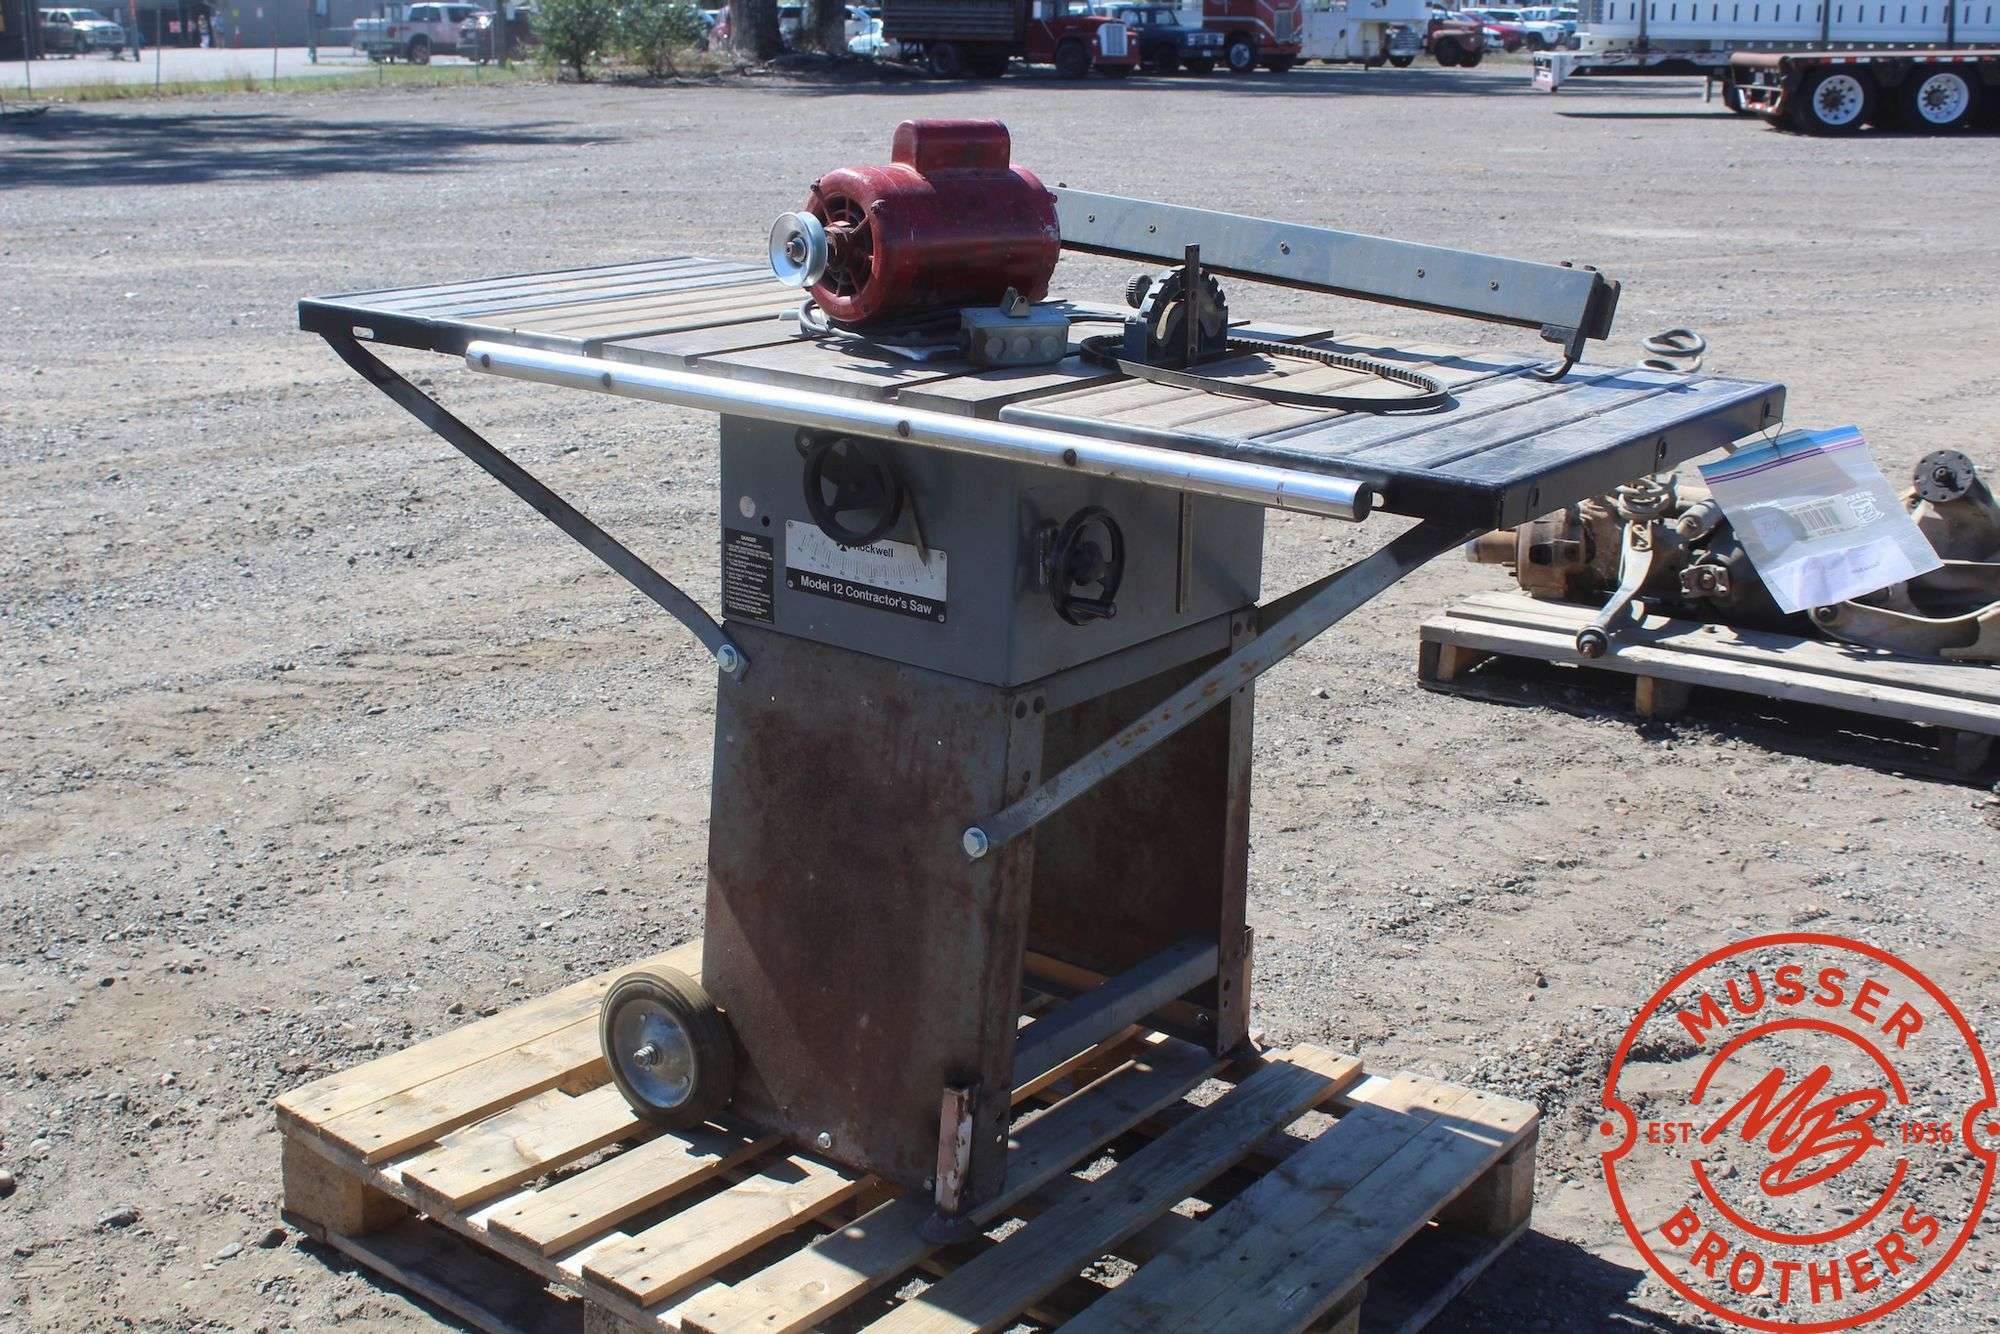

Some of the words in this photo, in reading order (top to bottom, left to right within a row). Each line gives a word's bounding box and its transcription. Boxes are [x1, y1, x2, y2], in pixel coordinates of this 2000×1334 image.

[800, 575, 830, 591] Model
[832, 583, 844, 595] 12
[845, 586, 908, 609] Contractor's
[909, 599, 933, 615] Saw
